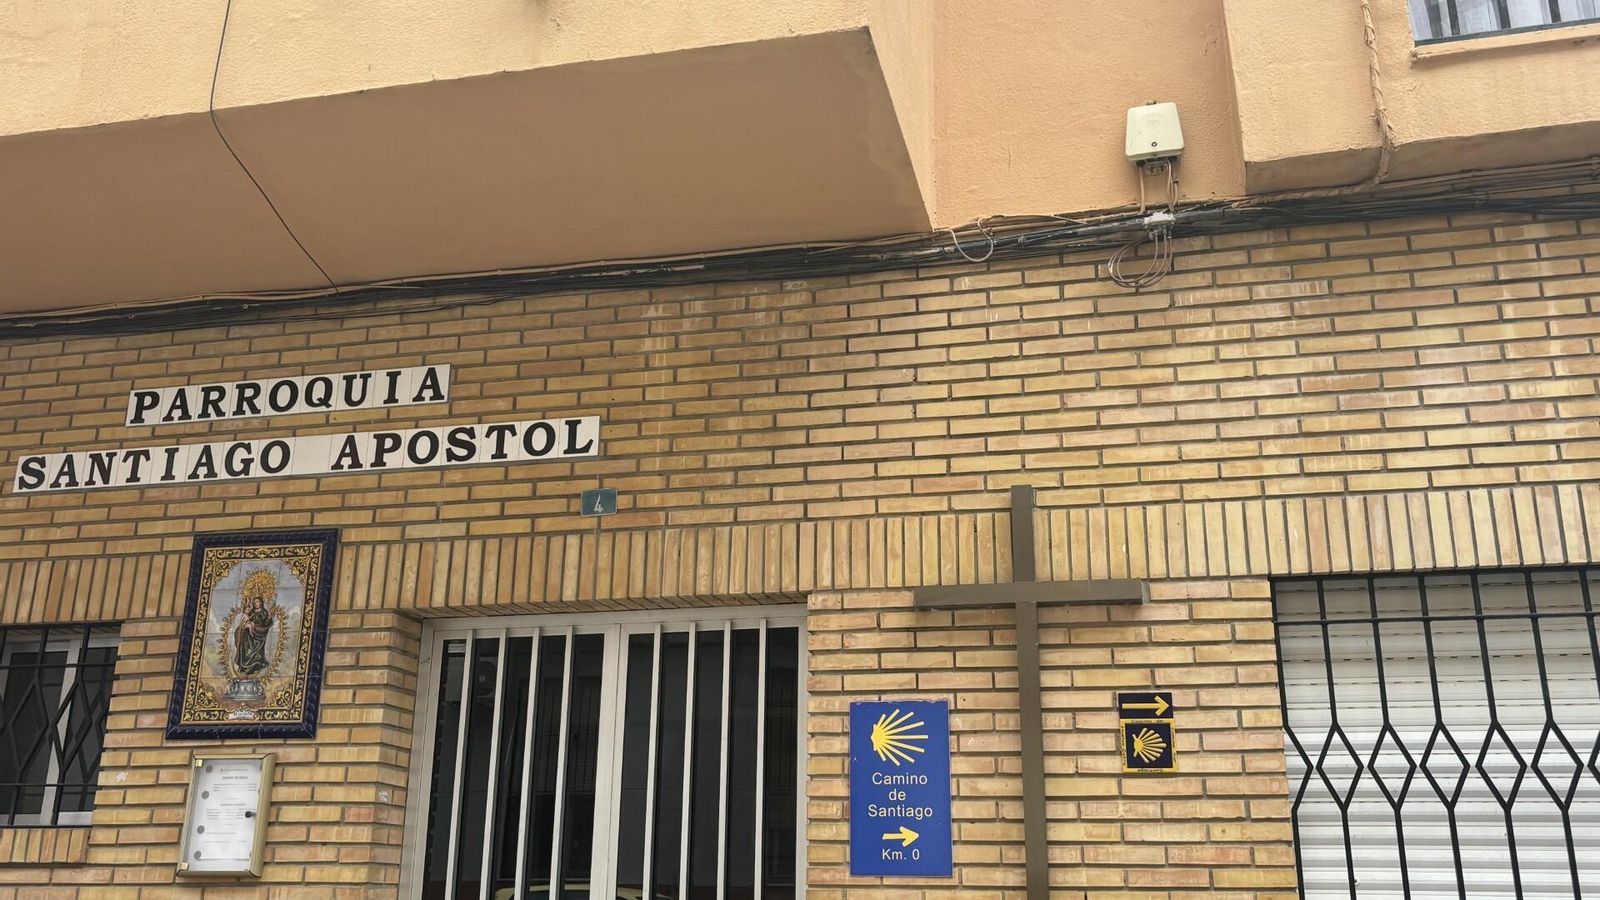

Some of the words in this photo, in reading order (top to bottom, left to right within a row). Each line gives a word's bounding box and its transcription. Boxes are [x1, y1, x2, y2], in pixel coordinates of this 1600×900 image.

[130, 367, 445, 424] PARROQUIA
[18, 440, 292, 491] SANTIAGO
[331, 419, 594, 470] APOSTOL
[593, 493, 604, 513] 4
[872, 772, 928, 785] Camino
[888, 789, 906, 801] de
[868, 804, 933, 820] Santiago
[882, 848, 907, 860] Km.
[912, 848, 920, 861] 0
